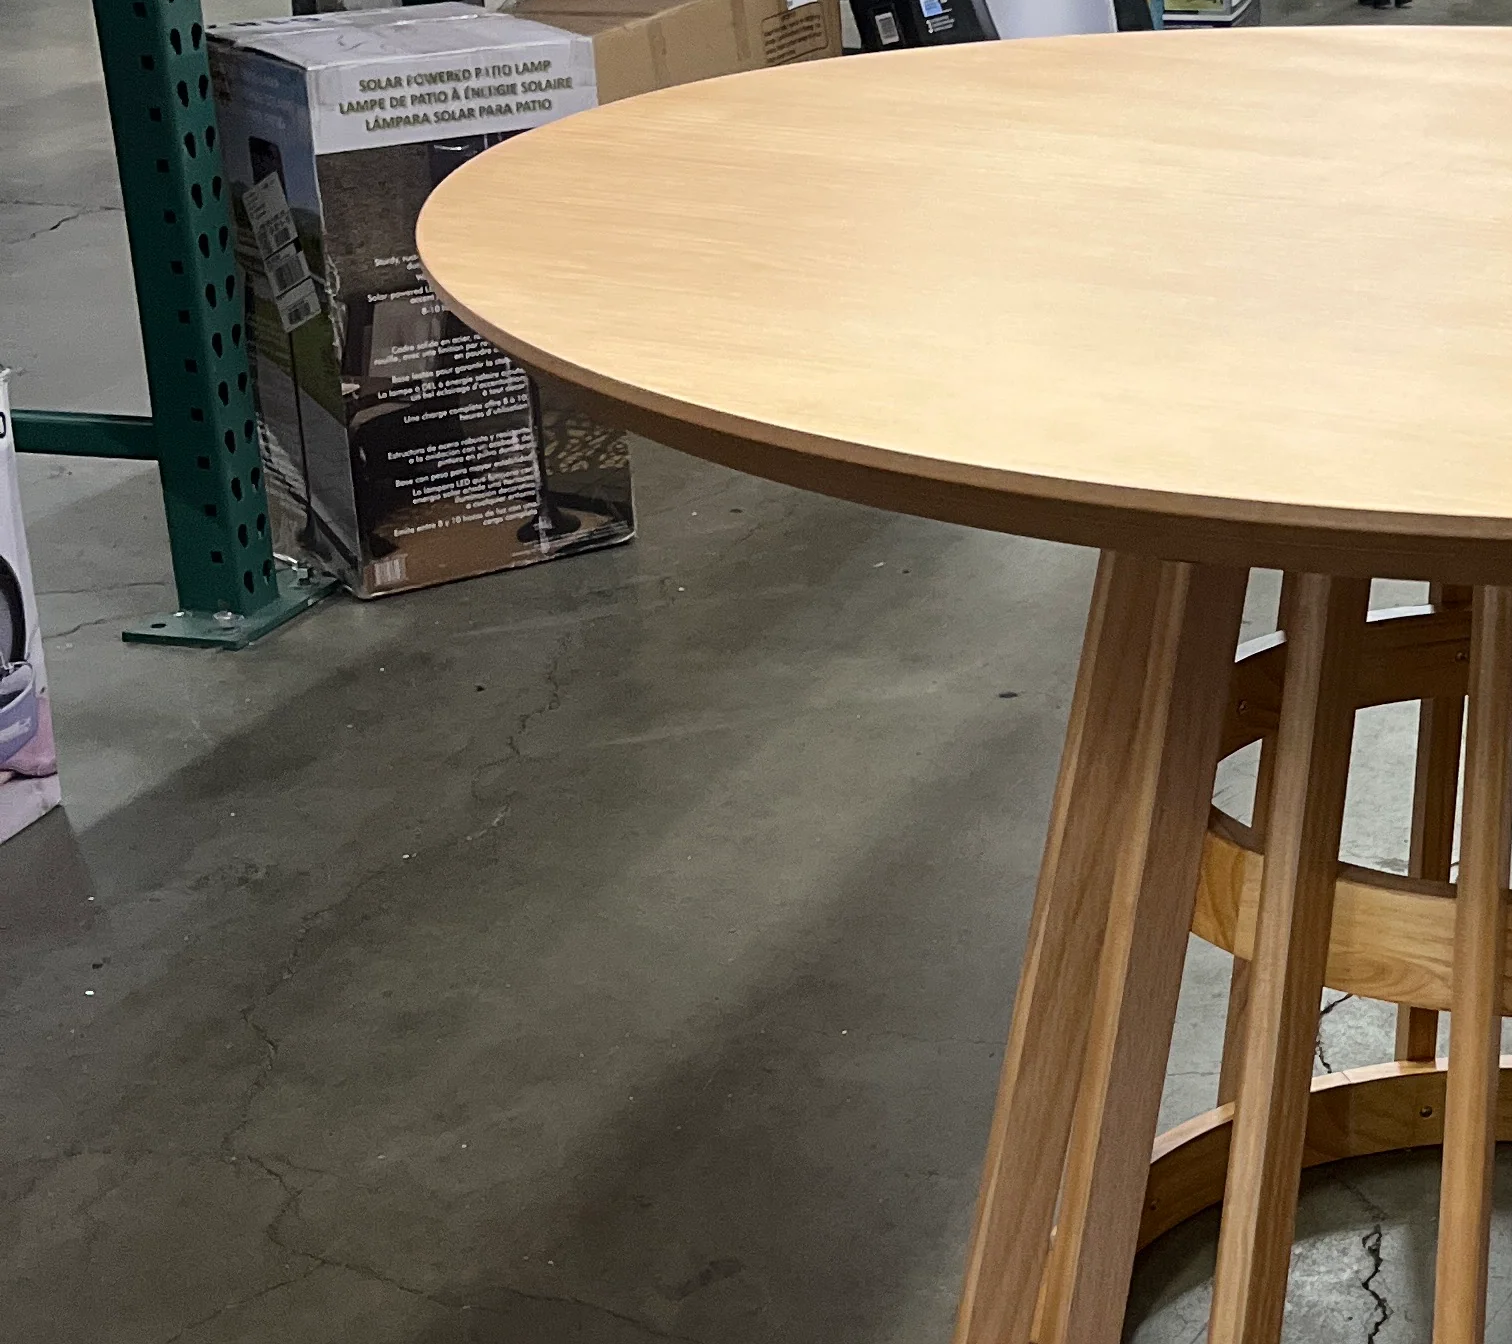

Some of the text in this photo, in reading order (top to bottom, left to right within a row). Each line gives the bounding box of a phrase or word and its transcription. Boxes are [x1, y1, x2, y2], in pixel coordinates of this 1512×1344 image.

[359, 59, 552, 93] SOLAR POWERED PATIO LAMP
[338, 96, 386, 115] LAMPE
[390, 94, 406, 108] DE
[411, 89, 449, 106] PATIO
[521, 76, 574, 94] SOLAIRE
[365, 97, 554, 132] LÁMPARA SOLAR PARA PATIO
